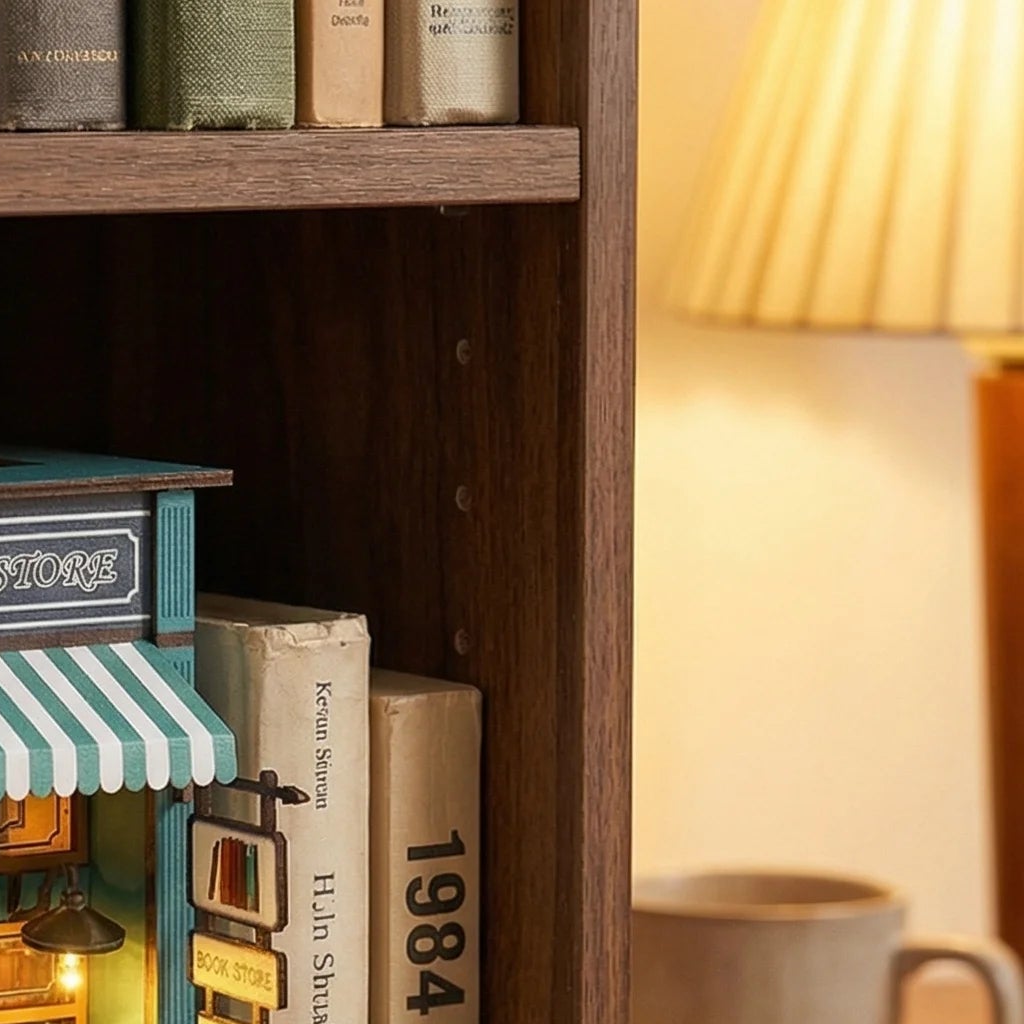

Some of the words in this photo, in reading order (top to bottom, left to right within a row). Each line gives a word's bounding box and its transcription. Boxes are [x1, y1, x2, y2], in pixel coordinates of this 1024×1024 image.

[196, 950, 230, 979] BOOK
[232, 961, 274, 992] STORE
[405, 829, 467, 1016] 1984
